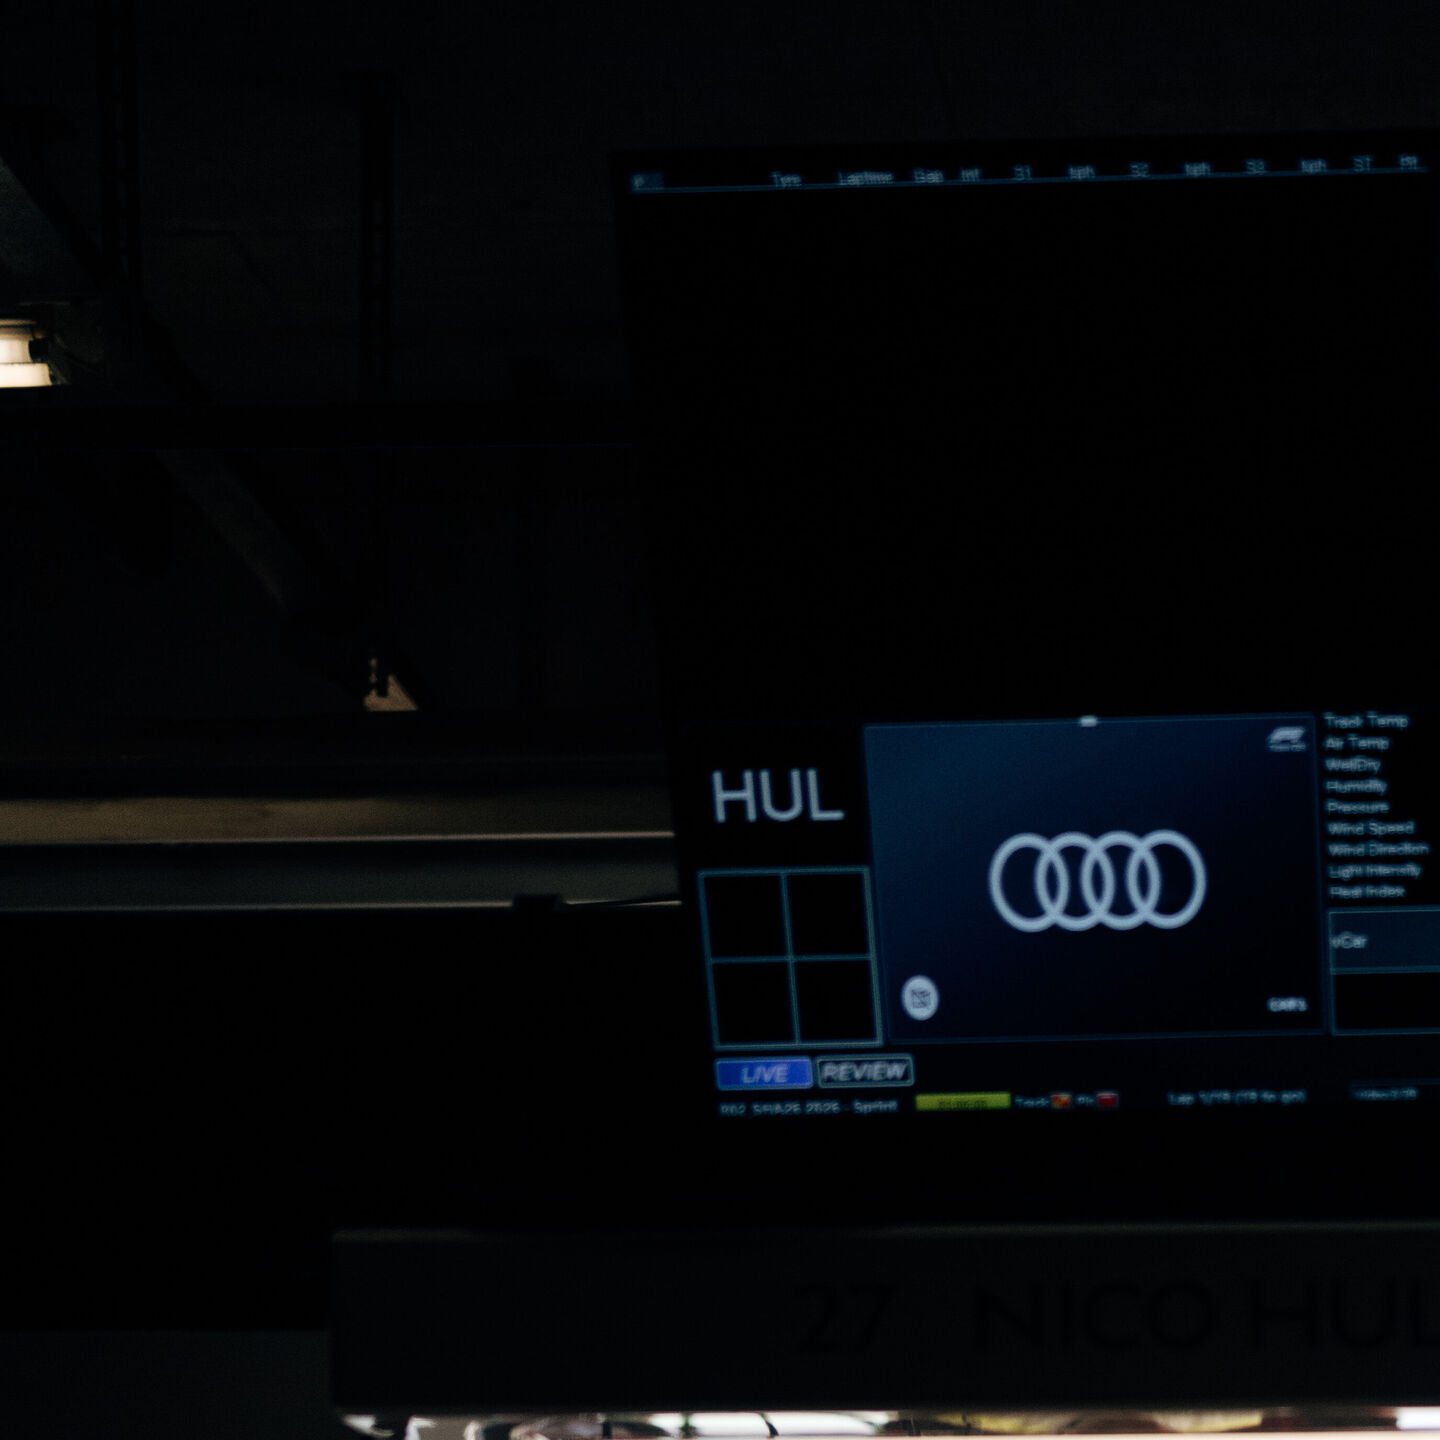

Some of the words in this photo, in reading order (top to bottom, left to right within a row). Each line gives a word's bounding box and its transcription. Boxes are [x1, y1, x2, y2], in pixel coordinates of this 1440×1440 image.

[1324, 712, 1362, 728] Track
[1368, 711, 1410, 730] Temp
[1326, 735, 1344, 749] Air
[1348, 733, 1389, 751] Temp
[712, 769, 844, 822] HUL
[1328, 820, 1364, 835] Wind
[1369, 819, 1416, 837] Speed
[1328, 842, 1365, 856] Wind
[741, 1064, 789, 1084] LIVE
[822, 1061, 907, 1082] REVIEW
[797, 1283, 896, 1353] 27
[972, 1278, 1214, 1353] NICO
